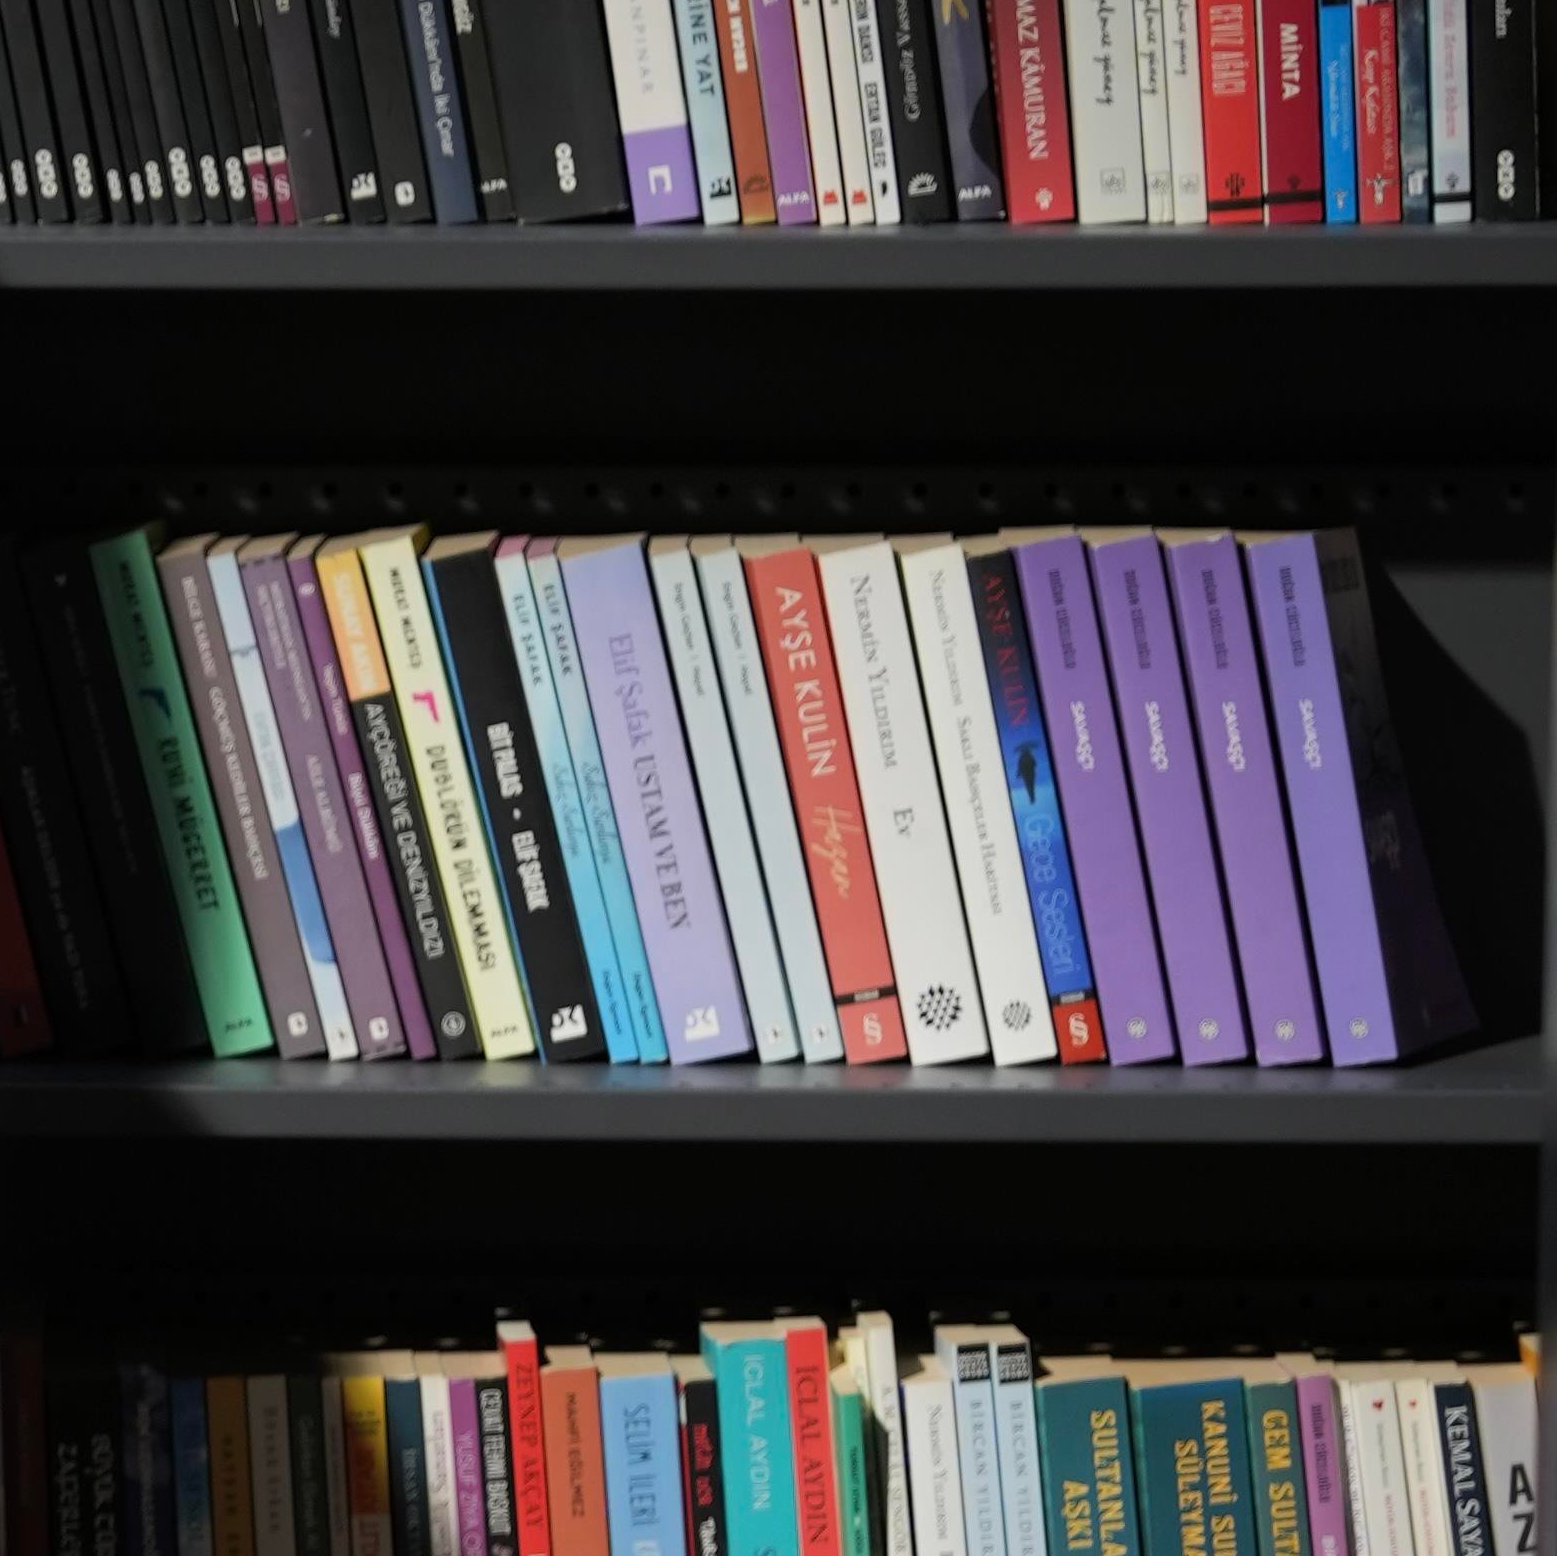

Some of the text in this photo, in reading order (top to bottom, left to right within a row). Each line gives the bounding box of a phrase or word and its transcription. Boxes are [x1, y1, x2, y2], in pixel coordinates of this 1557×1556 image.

[696, 54, 716, 98] YAT
[1279, 23, 1304, 100] MİNTA
[774, 585, 814, 673] AYŞE
[793, 679, 839, 779] KULİN
[390, 803, 414, 830] VE
[609, 632, 691, 931] Elif Şafak USTAM VE BEN
[623, 1404, 660, 1527] SELİM İLERİ
[748, 1435, 771, 1511] AYDIN
[1202, 1399, 1238, 1506] KANUNİ
[1261, 1409, 1291, 1471] CEM
[1443, 1404, 1475, 1494] KEMAL
[1060, 1479, 1093, 1550] AŞKI
